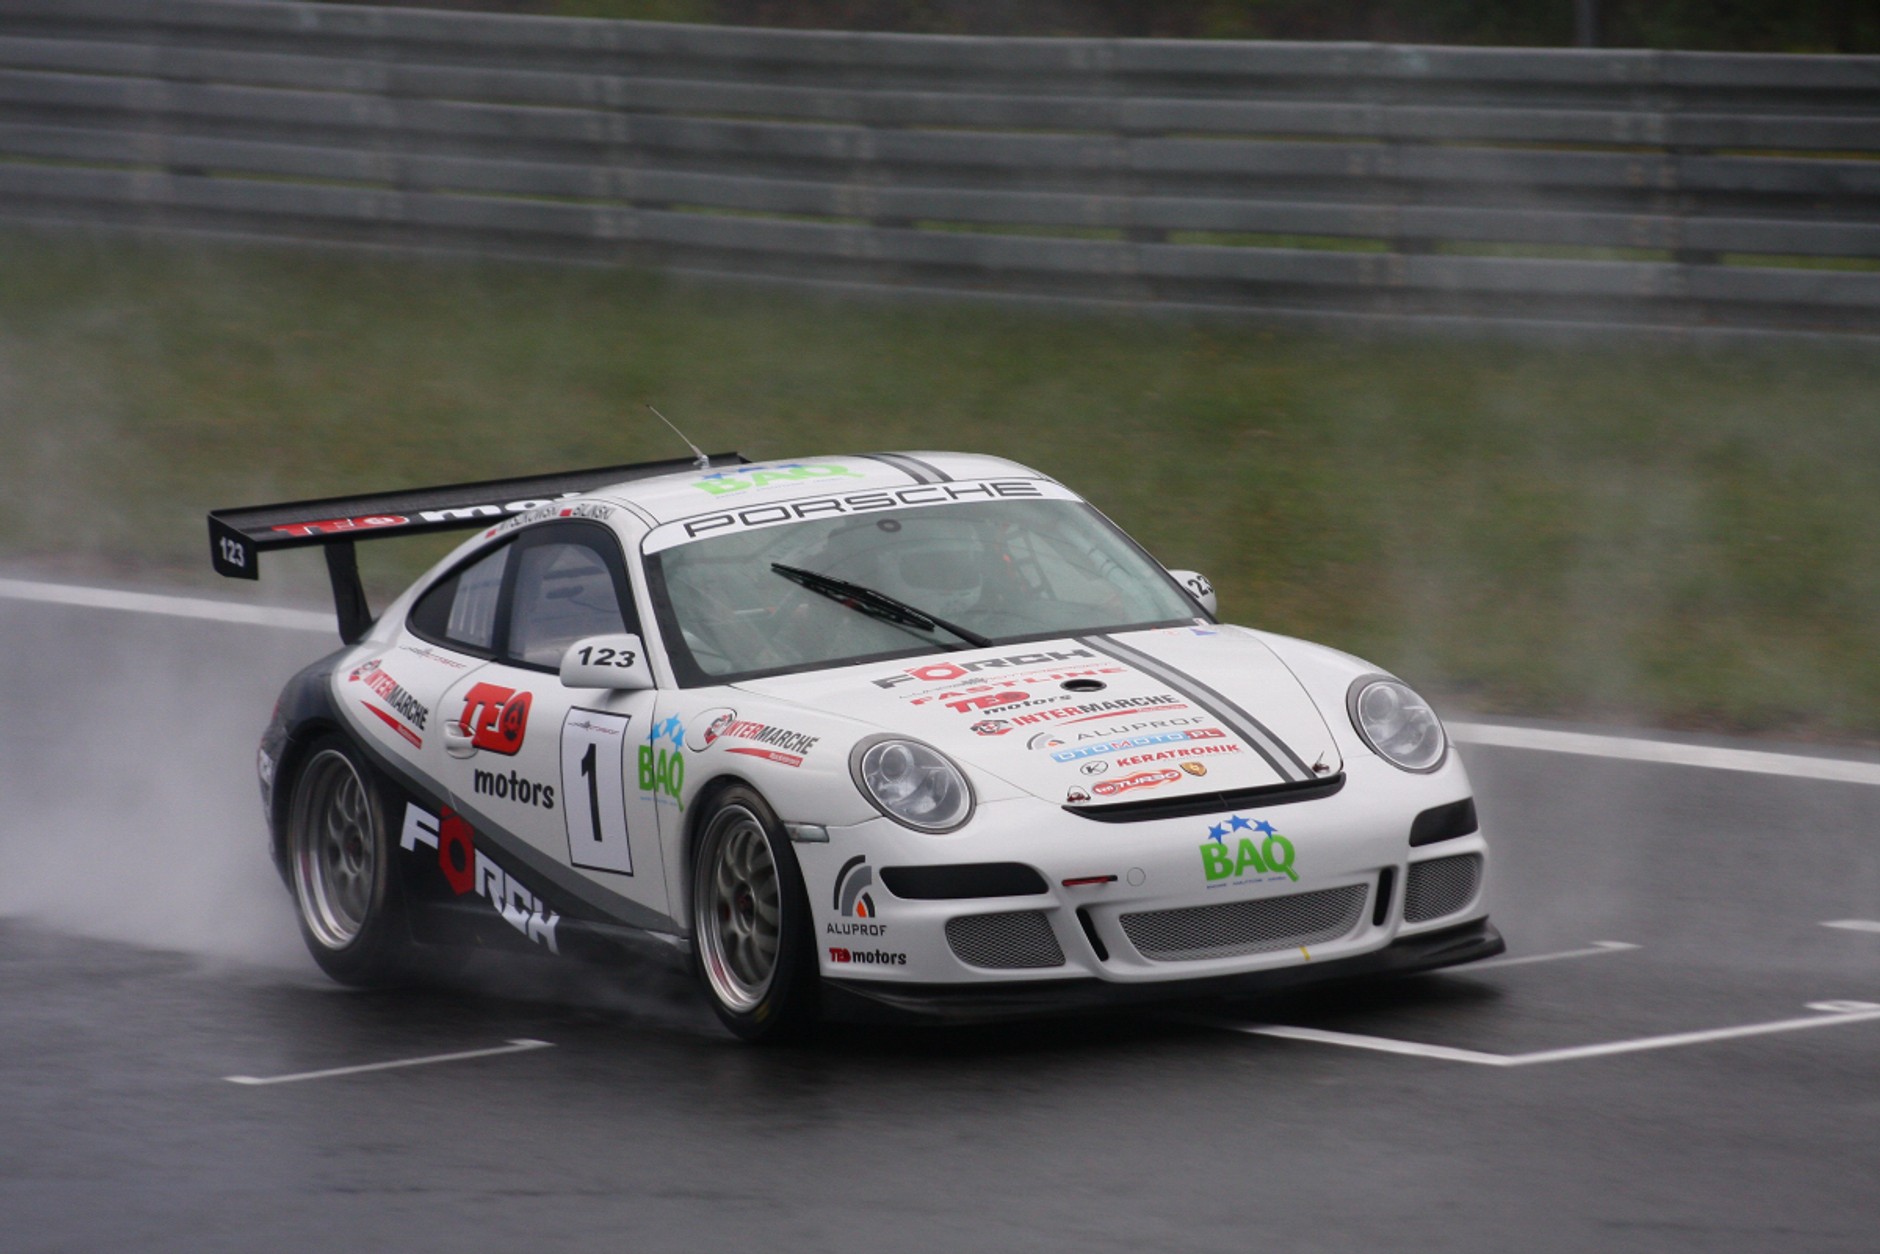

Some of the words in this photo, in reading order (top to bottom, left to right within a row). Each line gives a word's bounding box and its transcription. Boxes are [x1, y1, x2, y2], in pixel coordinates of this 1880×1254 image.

[691, 463, 865, 495] BAQ
[683, 482, 1043, 538] PORSCHE
[220, 536, 245, 567] 123
[578, 646, 636, 668] 123
[911, 667, 1128, 705] FASTLINE
[983, 694, 1072, 715] motors
[1011, 694, 1180, 727] INTERMARCHE
[721, 719, 820, 755] INTERMARCHE
[1076, 715, 1206, 741] ALUPROF
[1116, 743, 1241, 768] KERATRONIK
[474, 767, 555, 810] motors
[580, 743, 603, 842] 1
[638, 745, 685, 813] BAQ
[1200, 833, 1299, 883] BAQ
[827, 922, 888, 937] ALUPROF
[852, 948, 908, 965] motors
